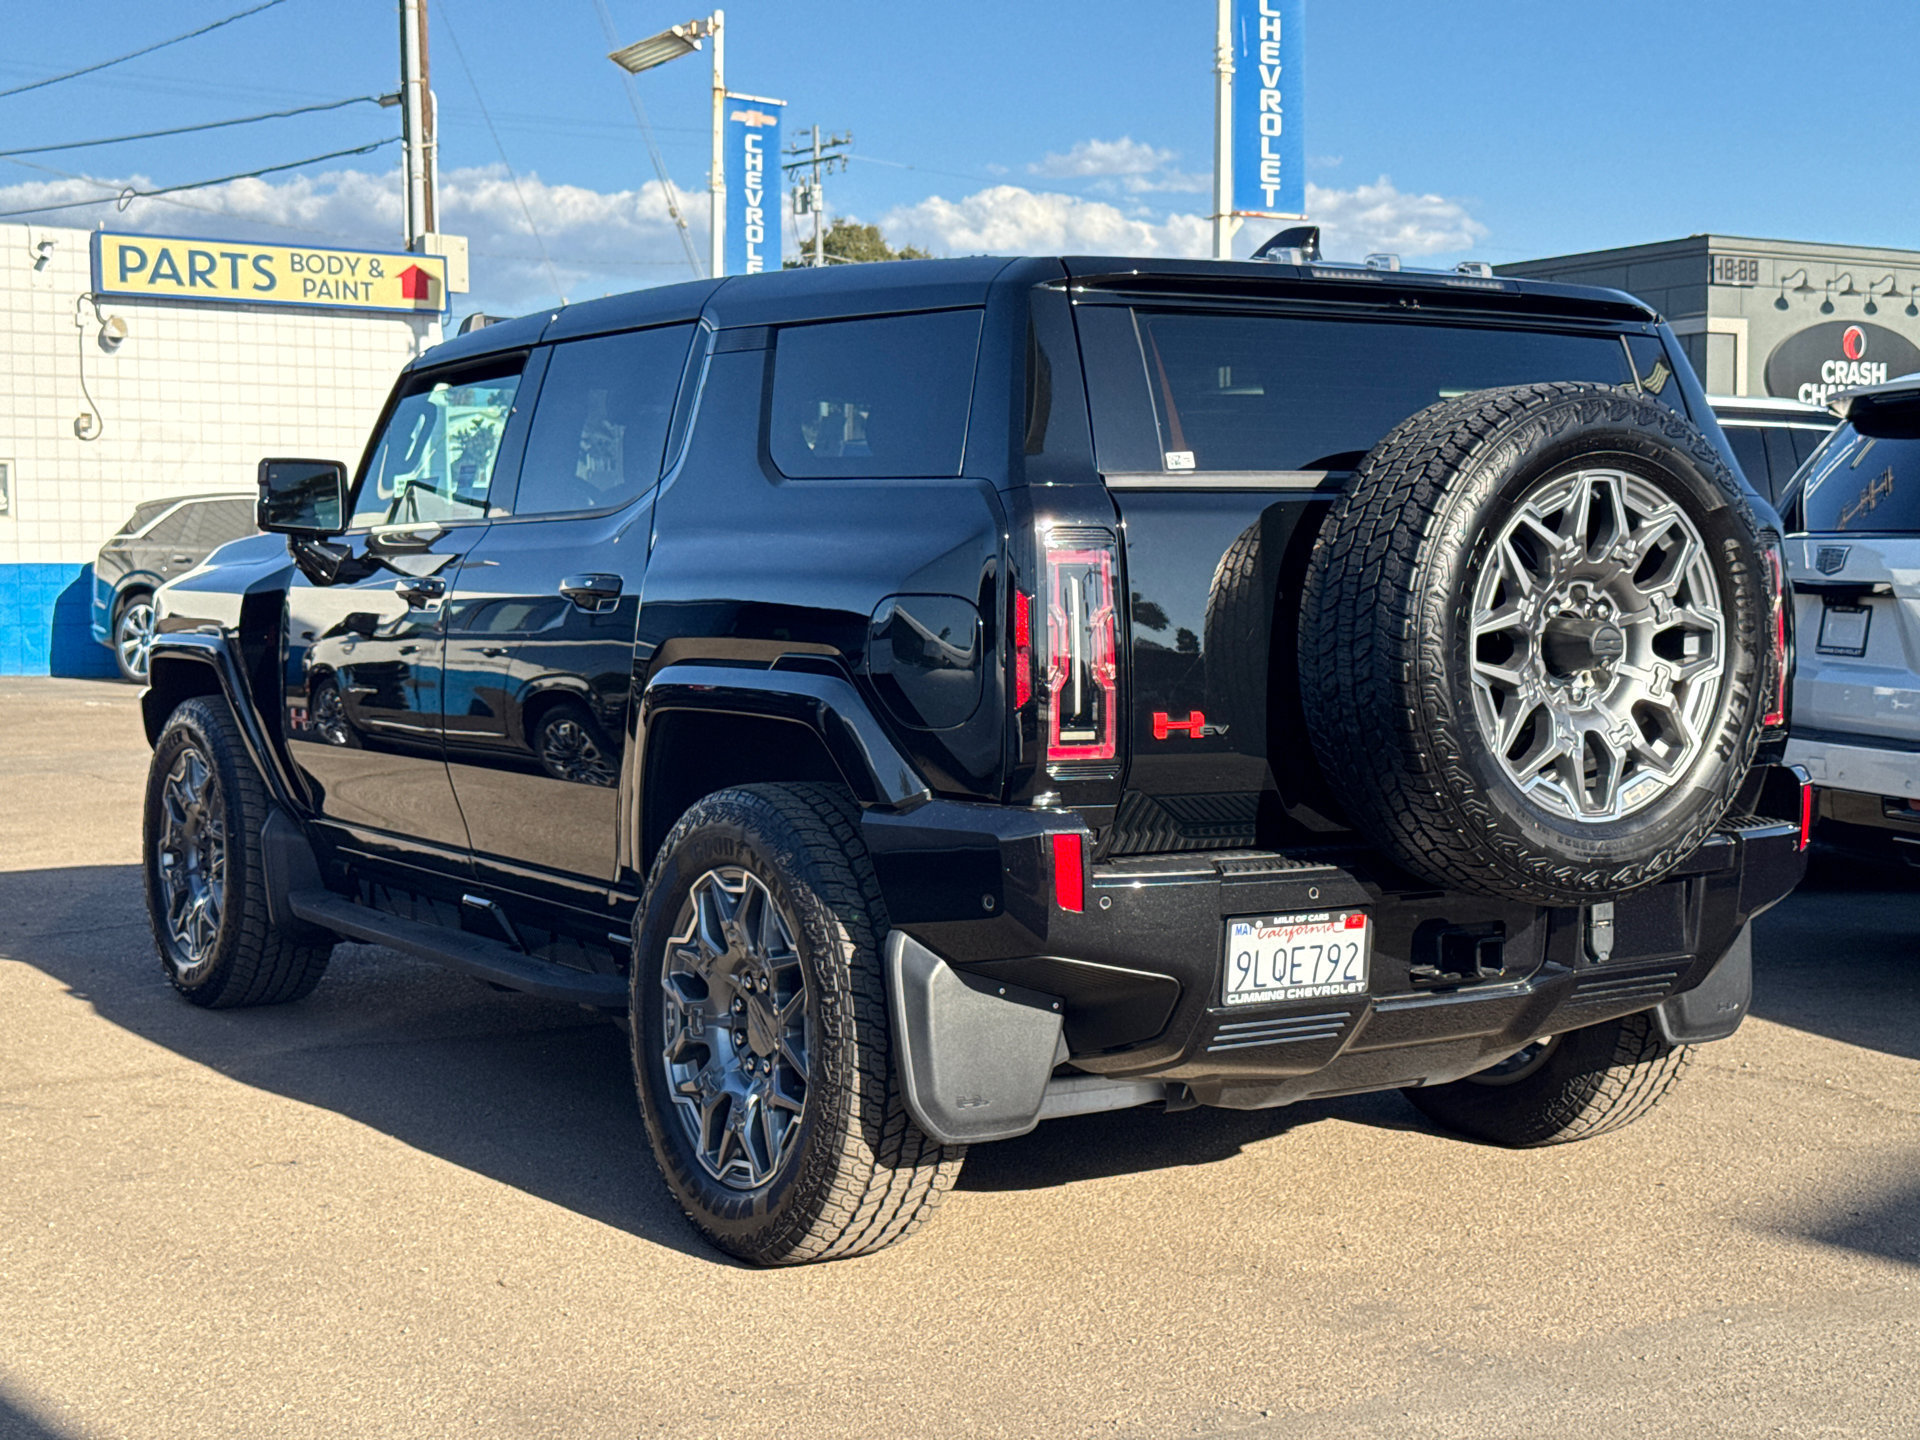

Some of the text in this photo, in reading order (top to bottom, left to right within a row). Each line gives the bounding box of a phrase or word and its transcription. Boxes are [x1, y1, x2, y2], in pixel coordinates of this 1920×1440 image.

[118, 244, 278, 292] PARTS
[290, 253, 385, 278] BODY &
[303, 278, 374, 301] PAINT
[1821, 360, 1887, 385] CRASH
[1273, 913, 1330, 925] MILE OF CARS
[1234, 942, 1359, 991] 9LQE792
[1227, 982, 1365, 1004] CUMMING CHEVROLET
